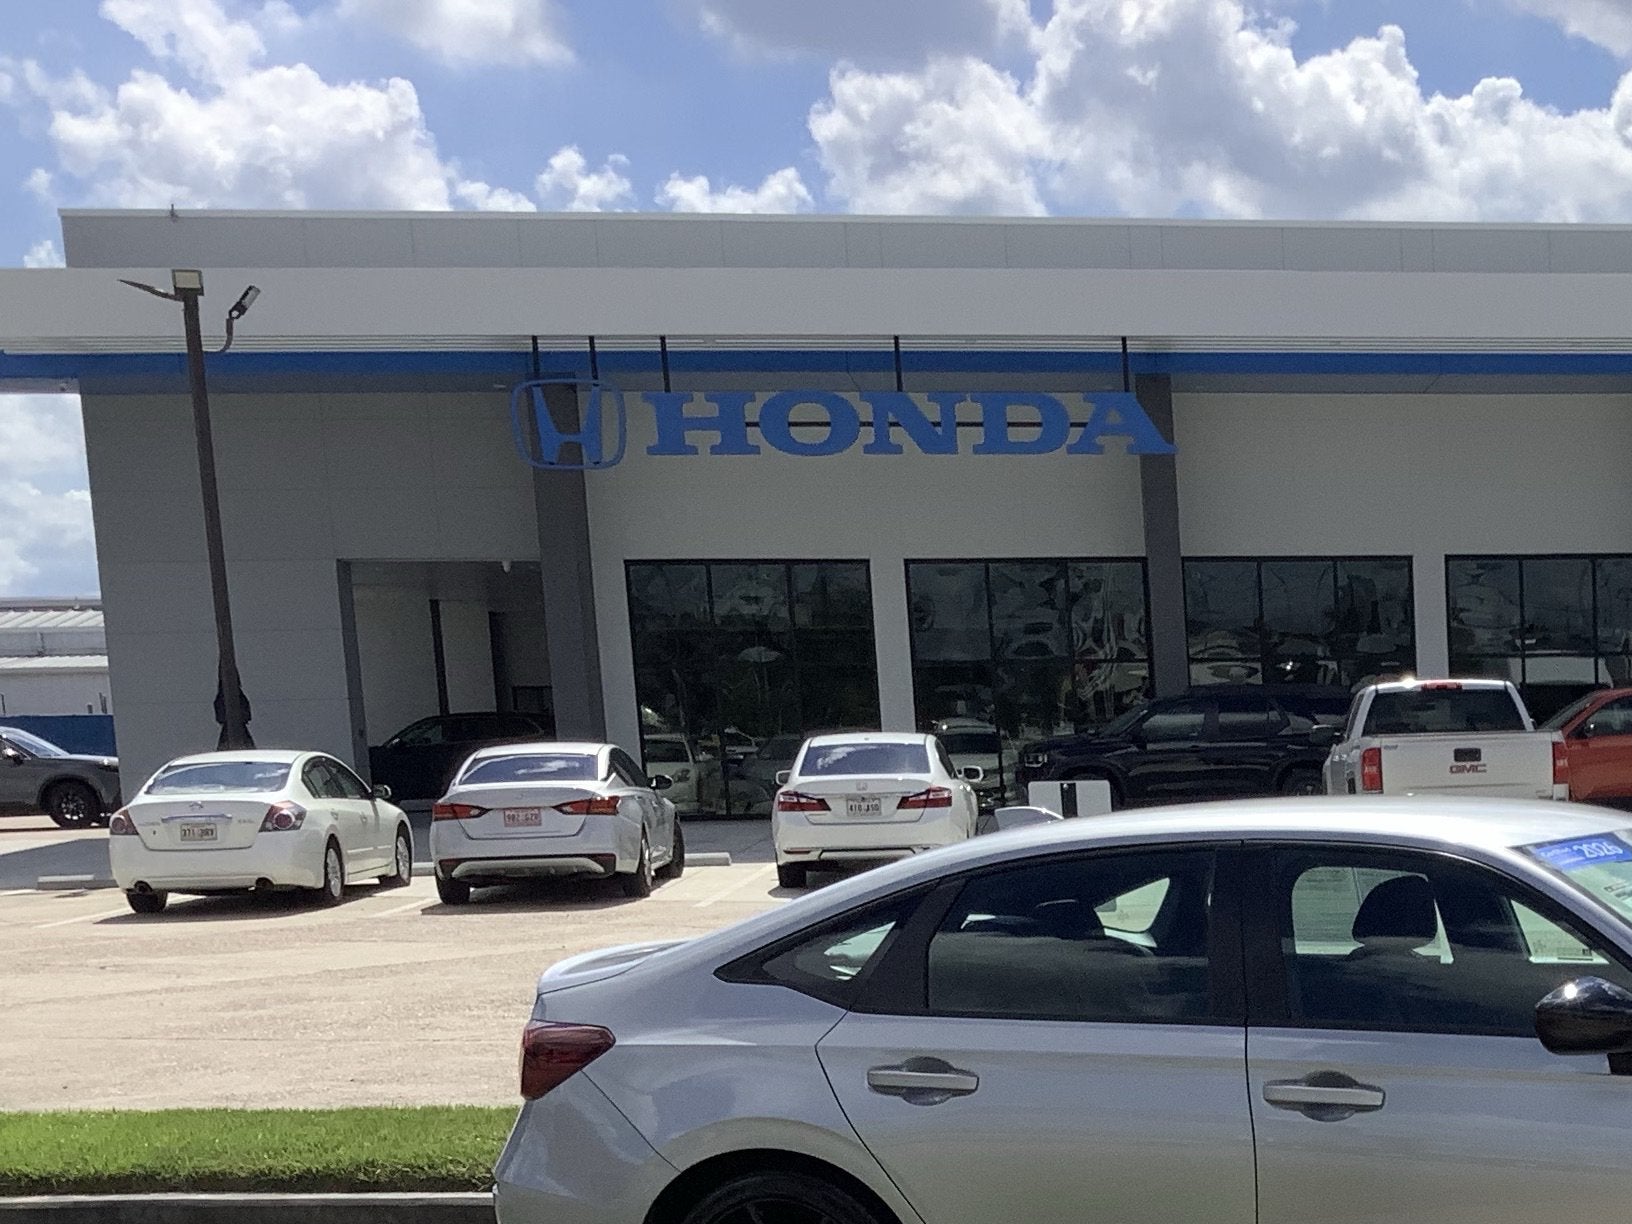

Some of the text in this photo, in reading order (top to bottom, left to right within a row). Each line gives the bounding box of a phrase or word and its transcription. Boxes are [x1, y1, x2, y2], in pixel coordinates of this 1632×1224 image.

[644, 391, 1177, 456] HONDA
[1450, 764, 1487, 773] GMC
[1573, 841, 1624, 859] 2026
